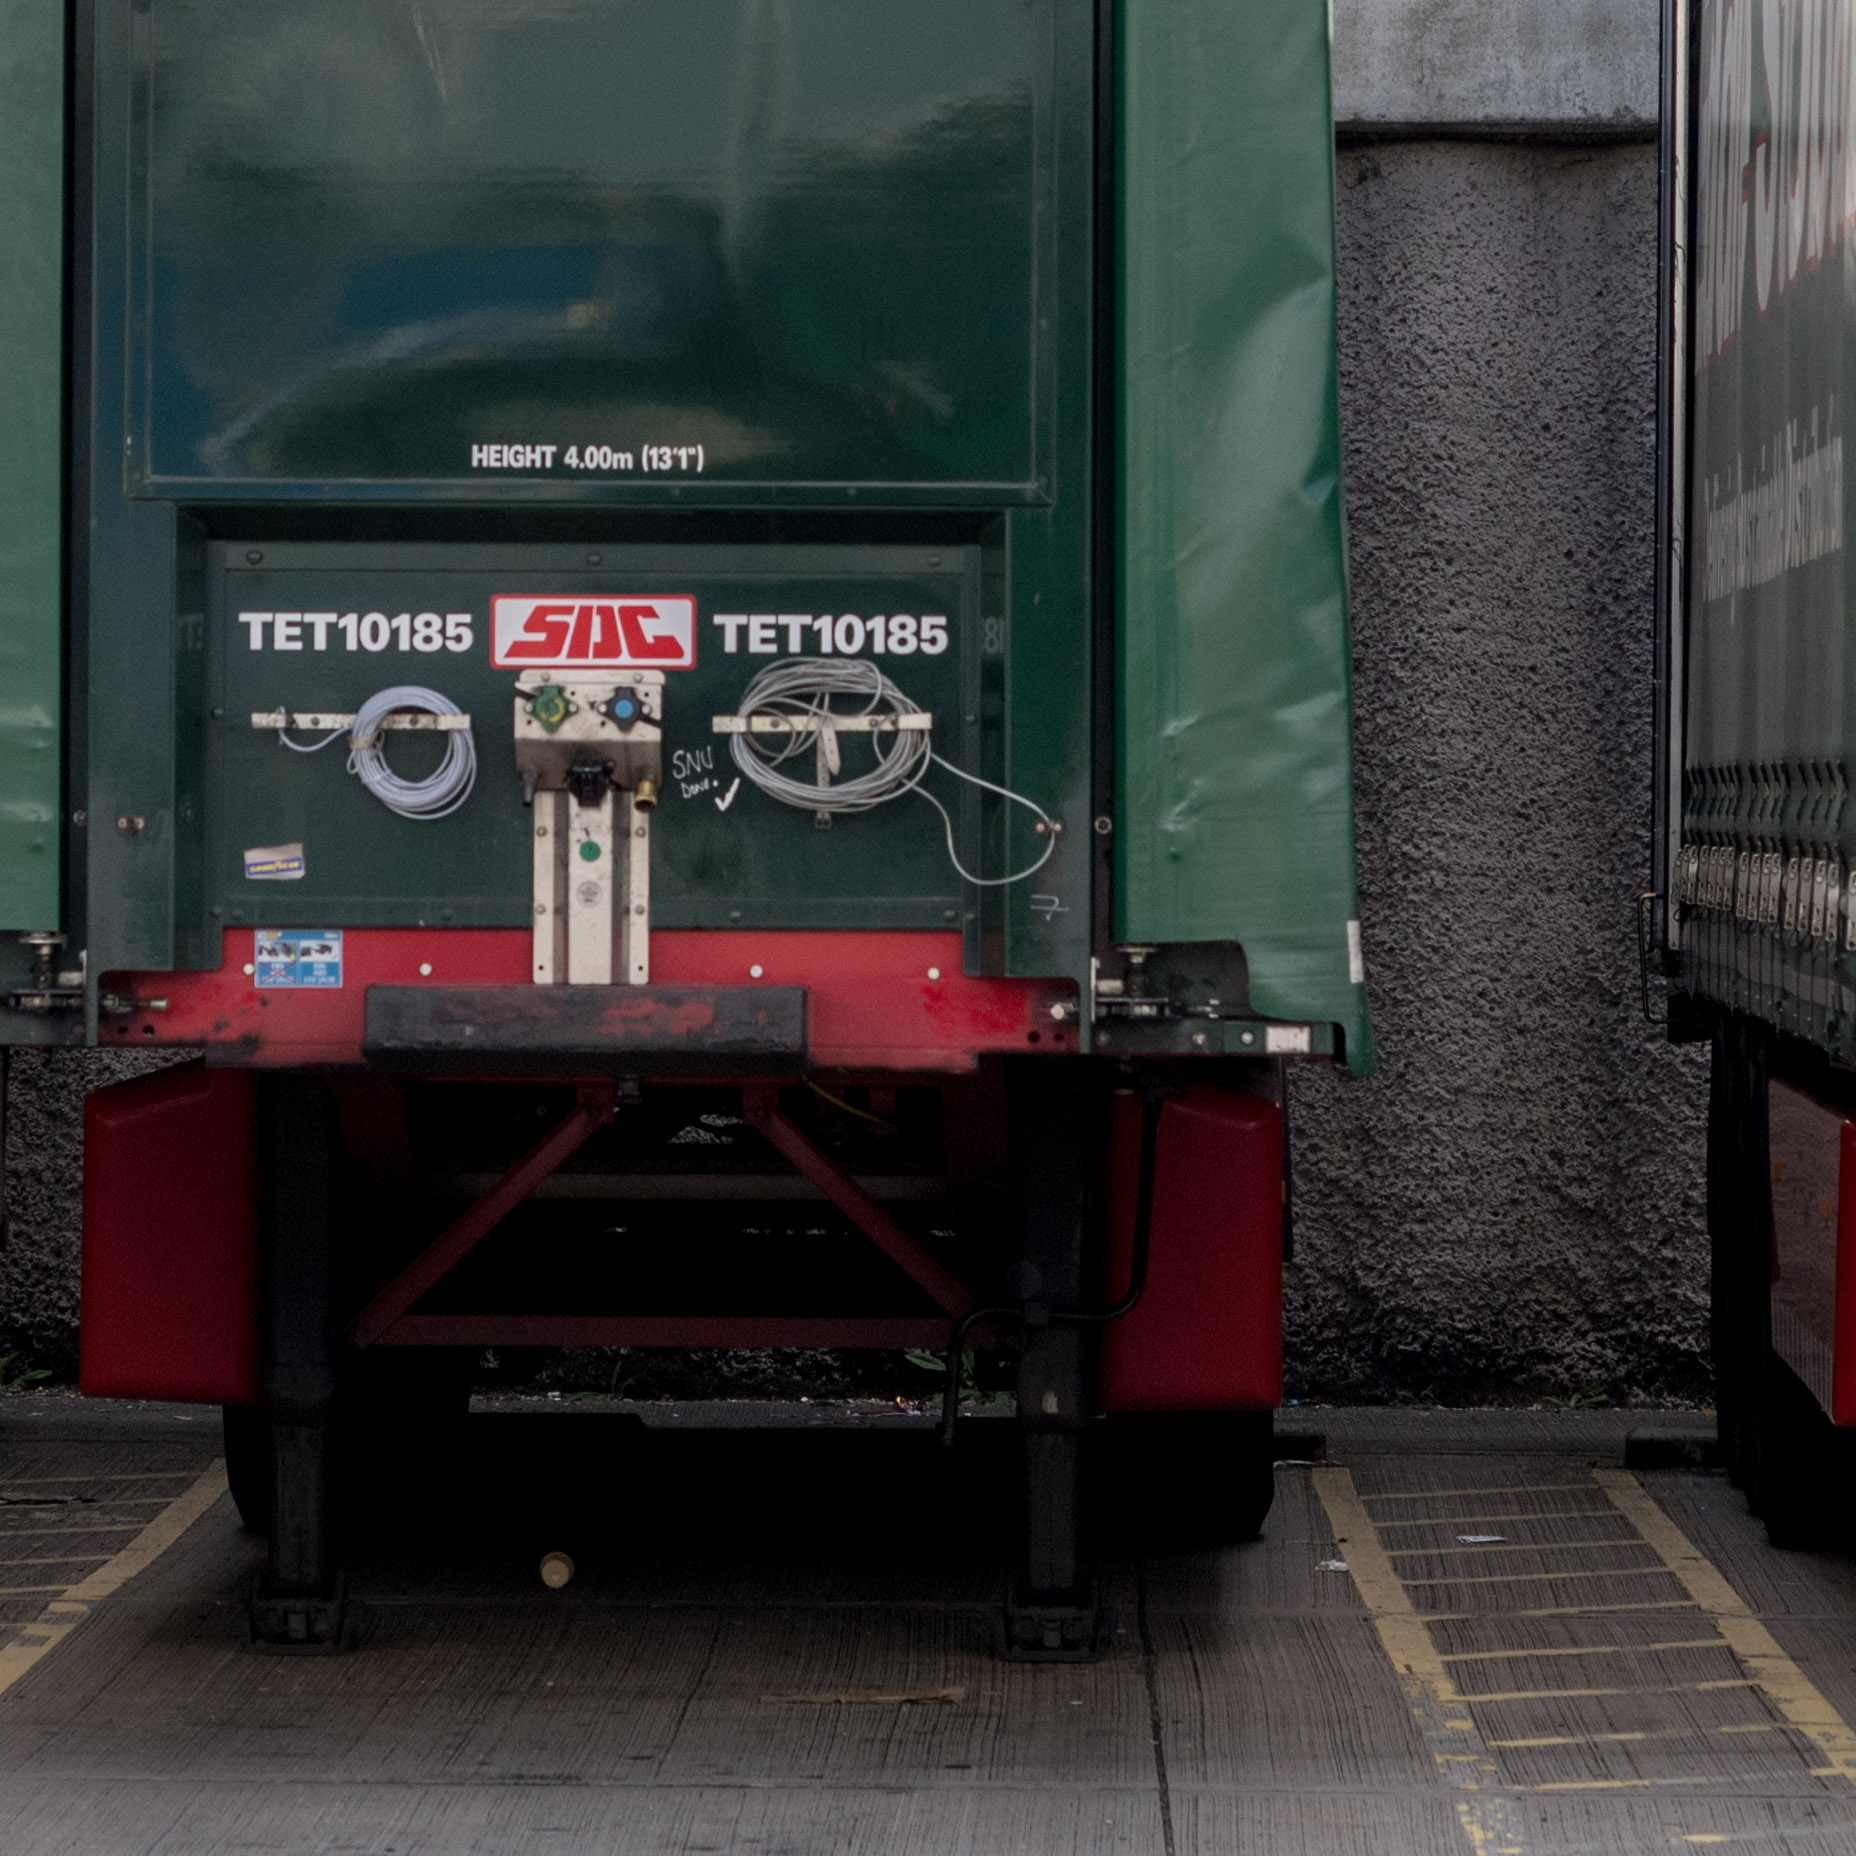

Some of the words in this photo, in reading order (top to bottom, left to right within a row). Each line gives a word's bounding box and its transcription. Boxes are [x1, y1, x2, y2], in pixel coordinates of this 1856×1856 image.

[471, 444, 558, 469] HEIGHT
[563, 445, 634, 470] 4.00m
[238, 611, 474, 653] TET10185
[504, 604, 685, 660] SDC
[712, 613, 949, 655] TET10185
